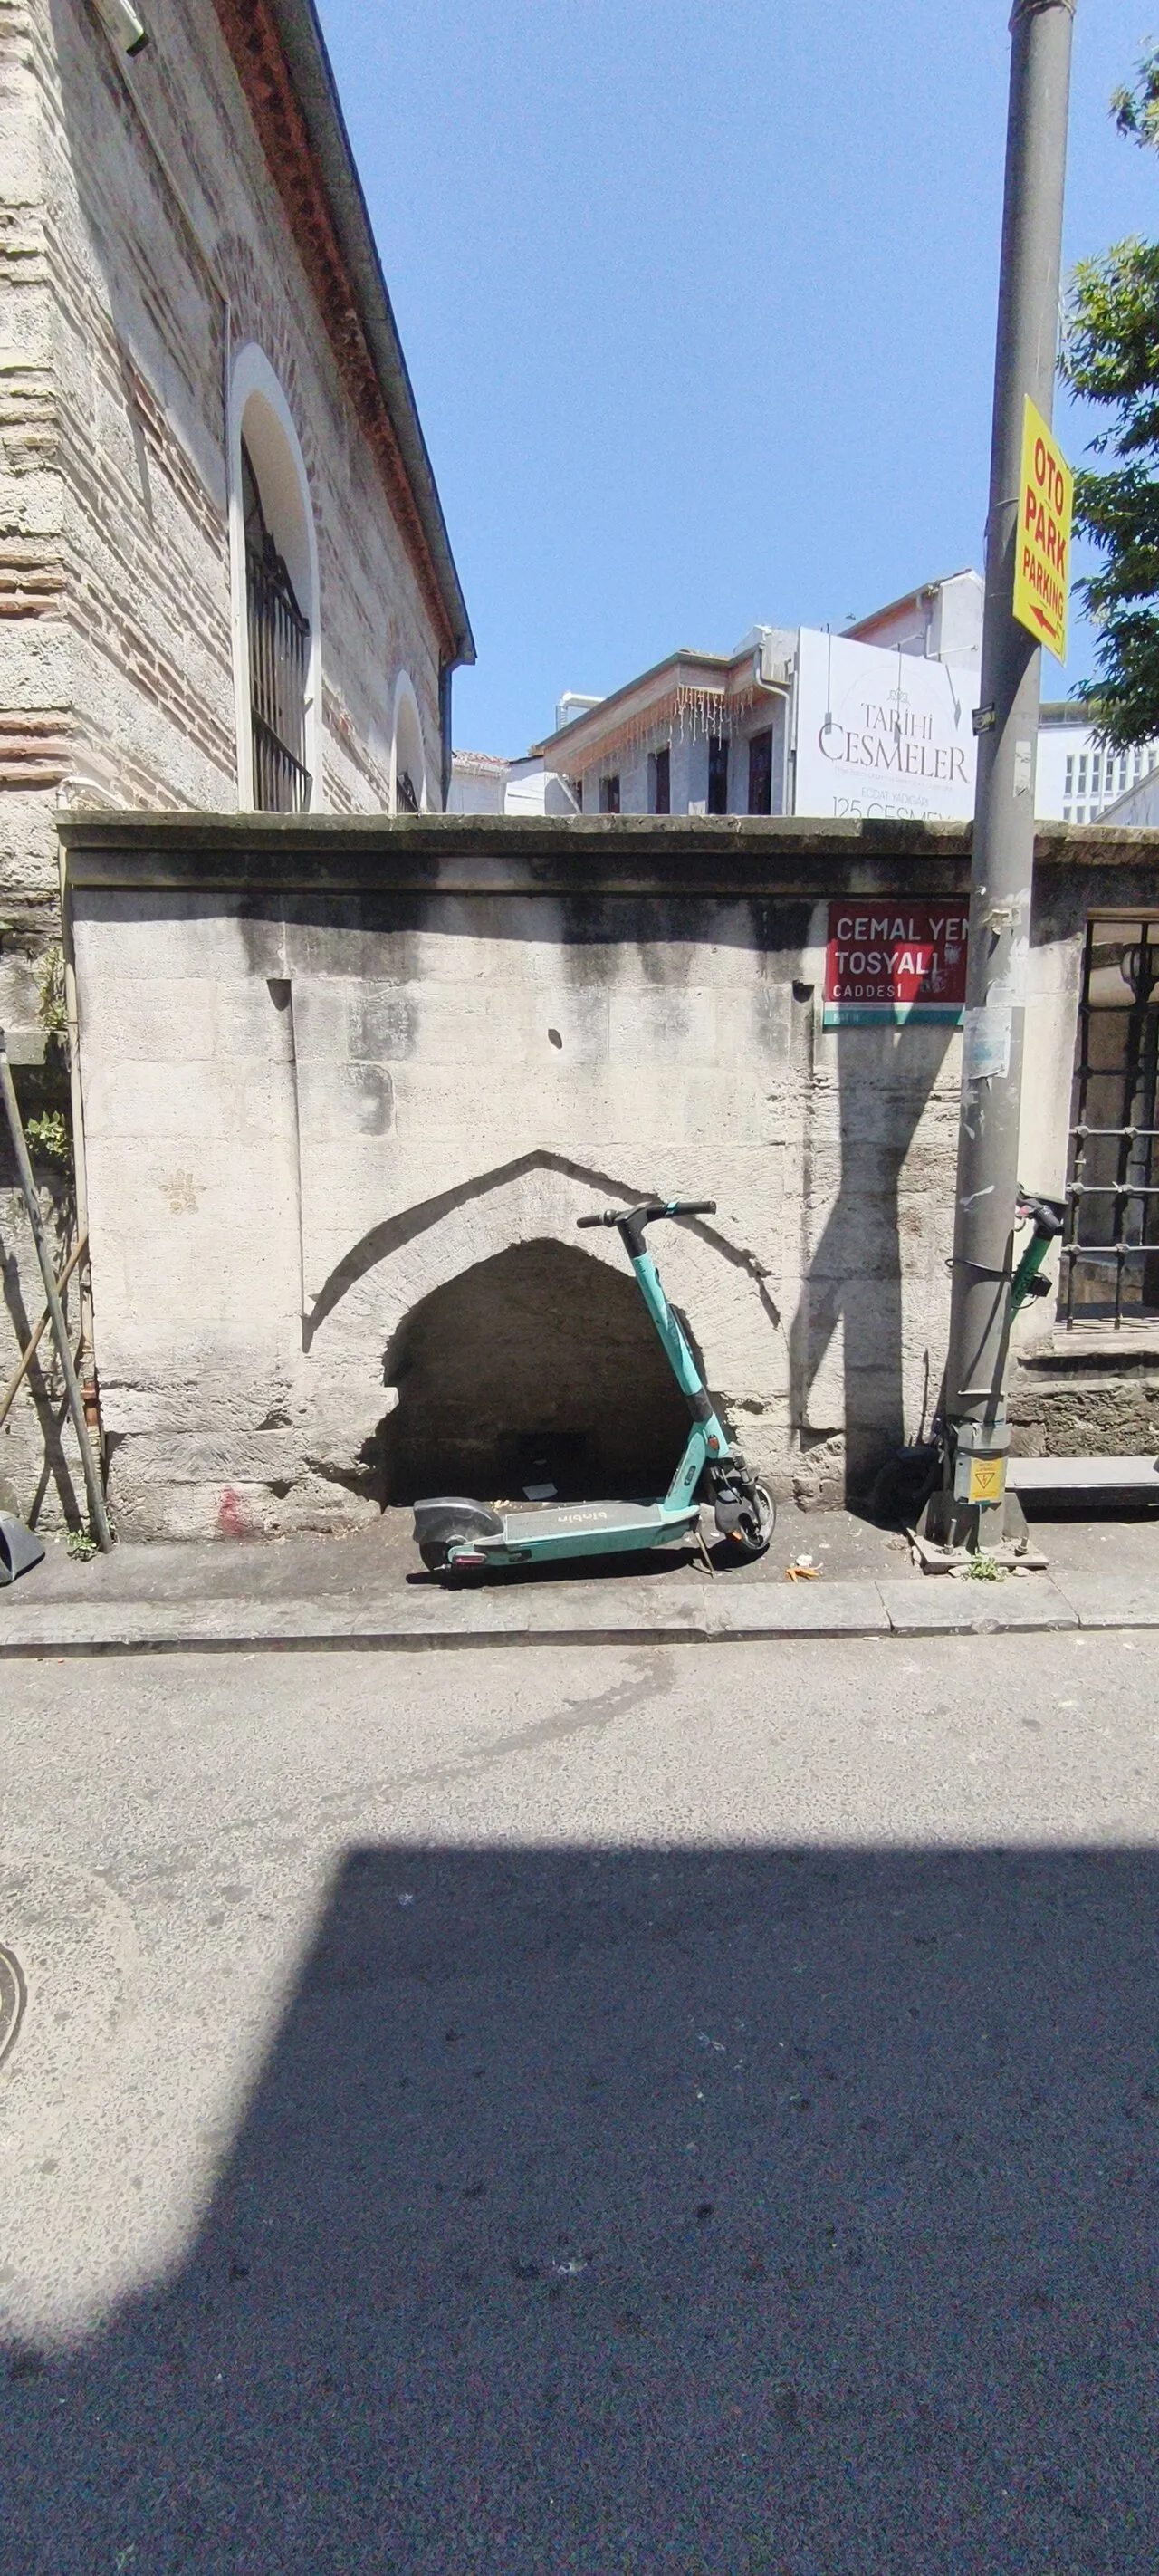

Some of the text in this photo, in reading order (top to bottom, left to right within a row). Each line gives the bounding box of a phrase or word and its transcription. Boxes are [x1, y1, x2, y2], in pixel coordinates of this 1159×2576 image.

[1034, 438, 1064, 515] OTO
[1025, 485, 1065, 581] PARK
[1023, 545, 1063, 620] PARKING
[837, 918, 921, 941] CEMAL
